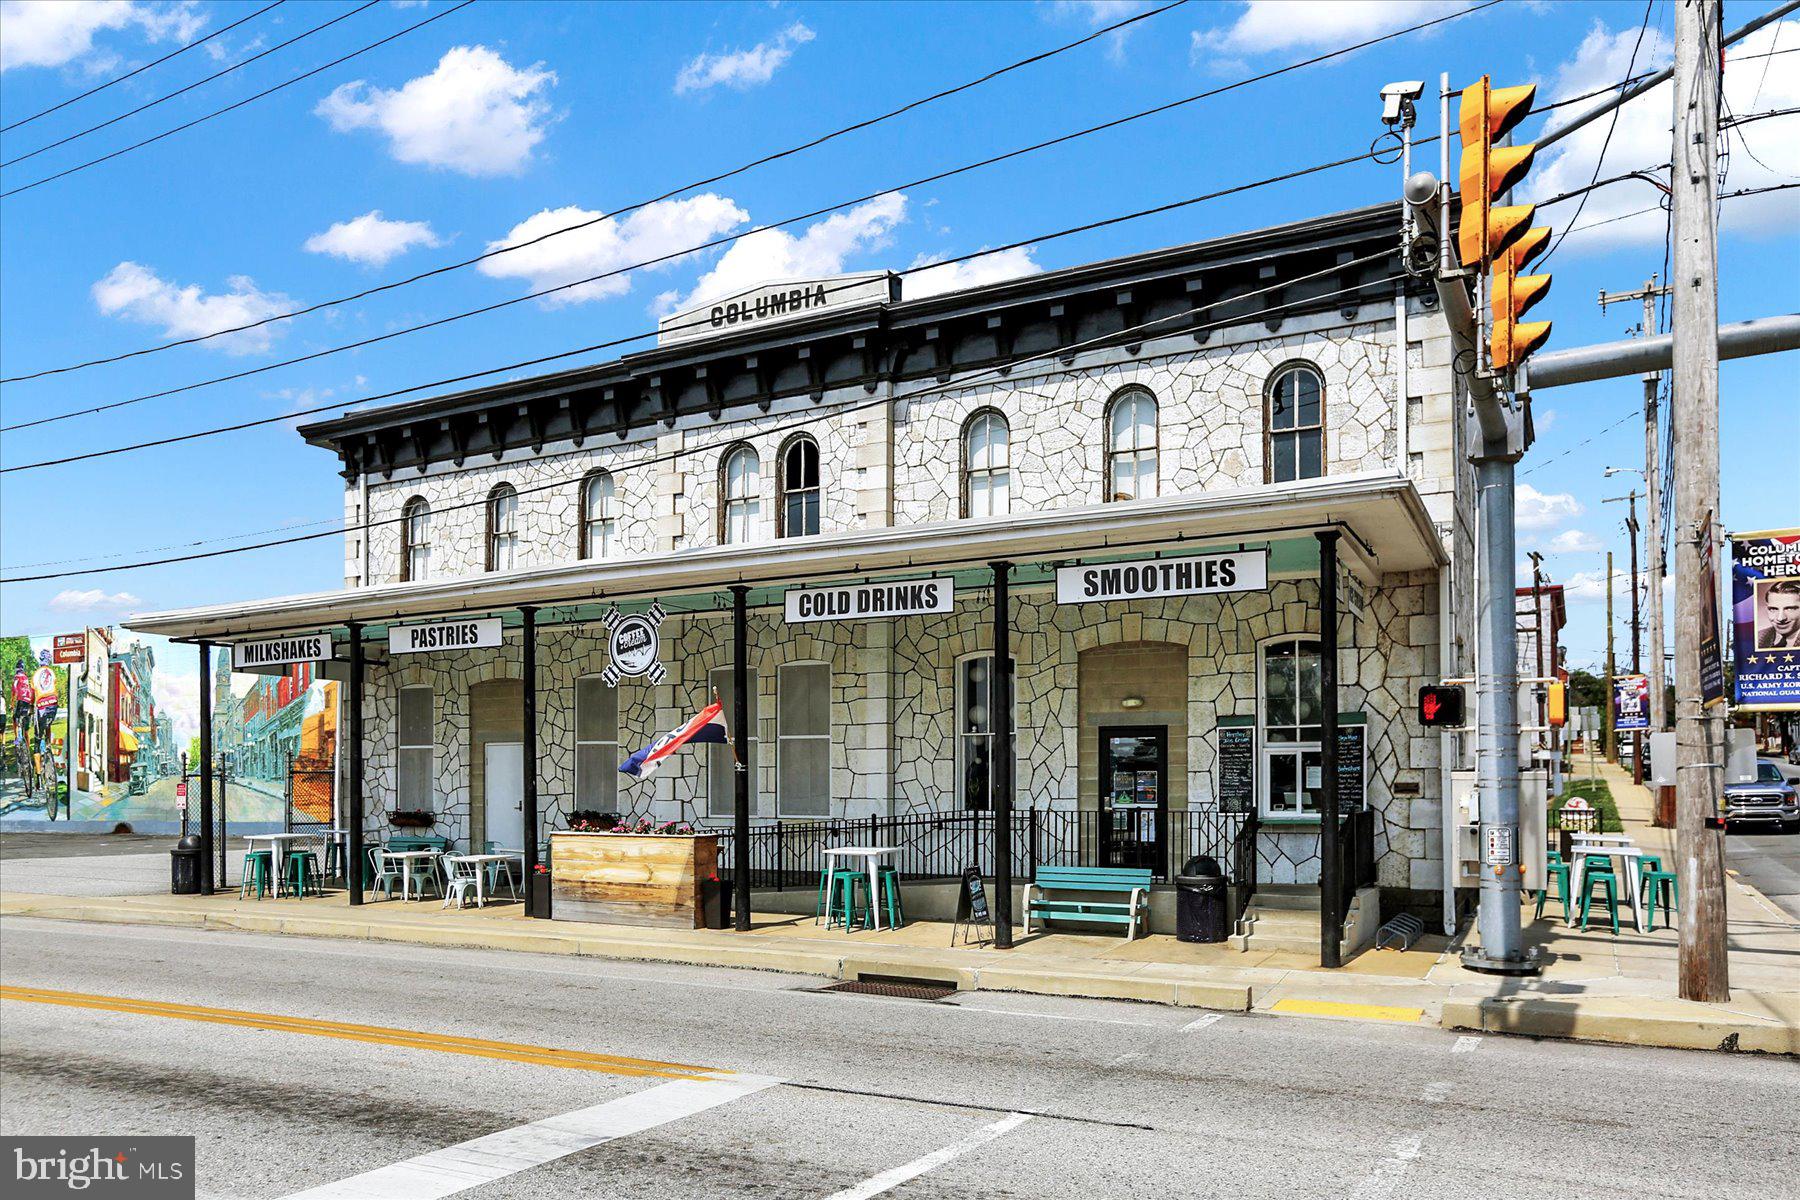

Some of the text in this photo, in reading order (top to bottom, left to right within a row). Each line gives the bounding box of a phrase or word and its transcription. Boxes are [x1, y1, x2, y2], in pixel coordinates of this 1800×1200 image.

[711, 284, 827, 327] COLUMBIA
[1083, 558, 1236, 597] SMOOTHIES
[799, 583, 938, 618] COLD DRINKS
[411, 623, 478, 648] PASTRIES
[619, 627, 646, 644] COFFEE
[244, 638, 321, 663] MILKSHAKES
[1739, 672, 1783, 681] RICHARD
[1784, 672, 1795, 680] K.
